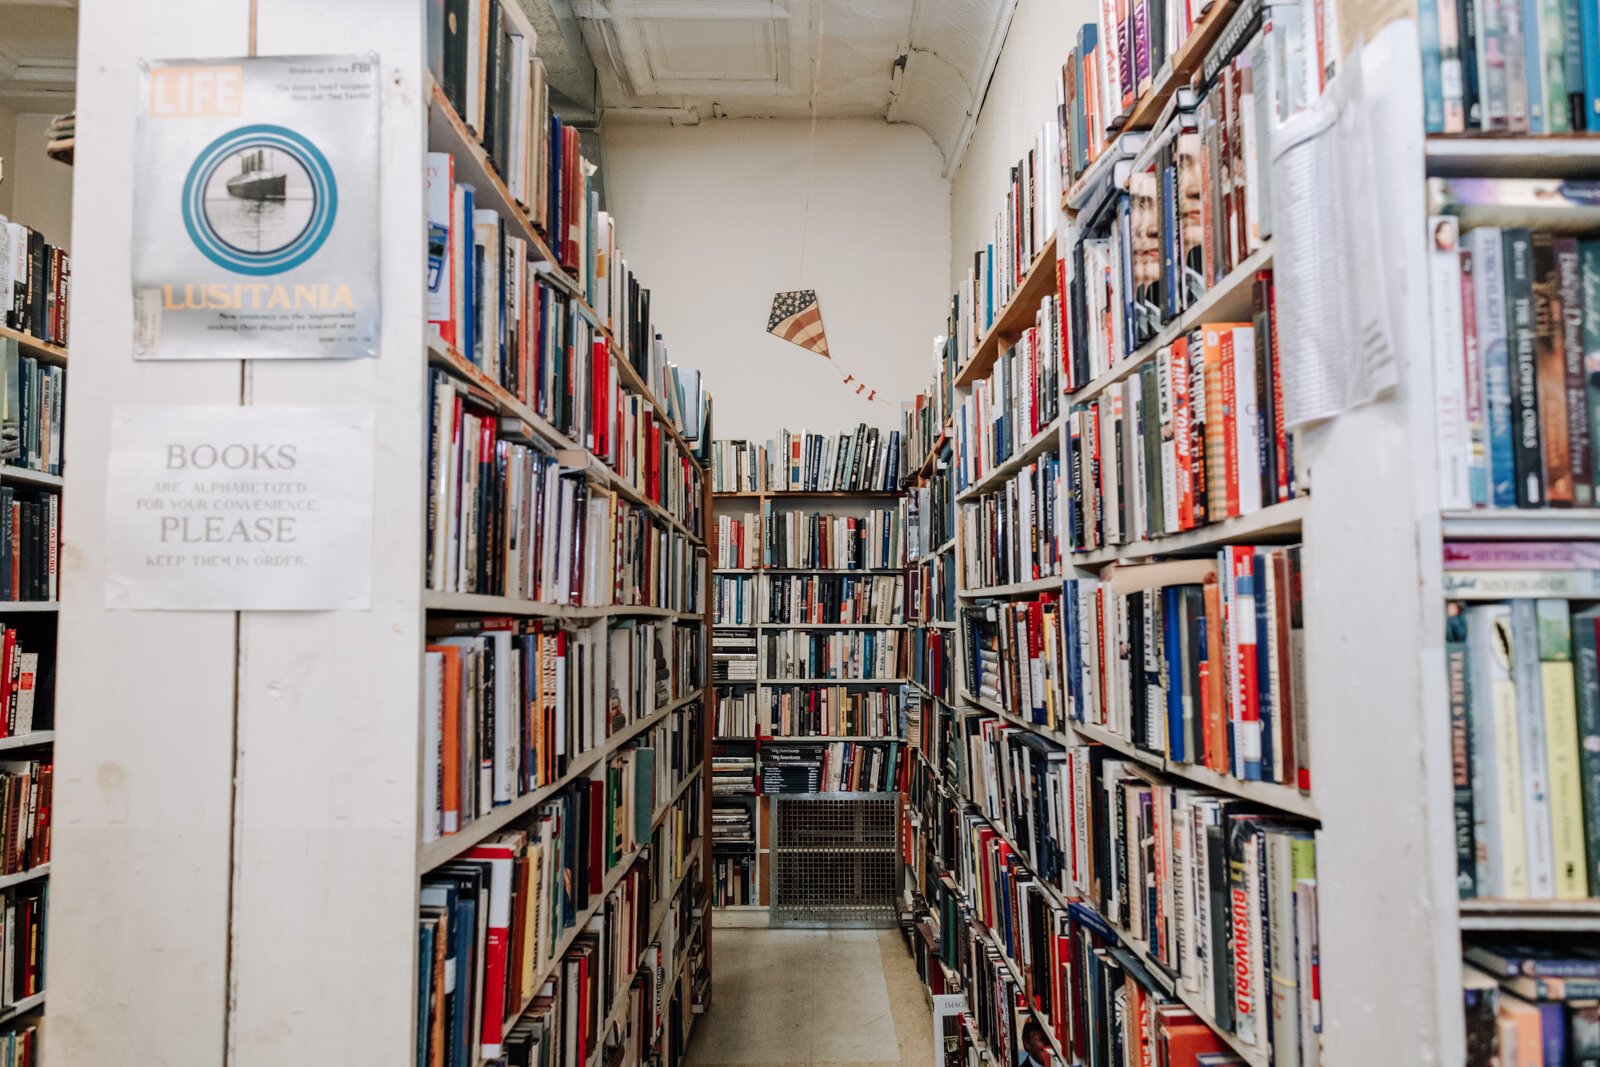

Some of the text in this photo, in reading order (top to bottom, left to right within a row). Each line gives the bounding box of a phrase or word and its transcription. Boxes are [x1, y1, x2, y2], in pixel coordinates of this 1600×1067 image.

[352, 63, 371, 73] FBI
[156, 71, 239, 113] LIFE
[163, 283, 356, 311] LUSITANIA
[1485, 238, 1502, 335] TORCHLIGHT
[207, 322, 237, 332] sinking
[240, 322, 256, 330] that
[260, 322, 293, 332] dragged
[308, 322, 337, 330] toward
[218, 311, 237, 320] New
[239, 312, 276, 320] evidence
[292, 311, 304, 320] the
[1515, 298, 1530, 326] THE
[1174, 356, 1187, 394] THIS
[1517, 328, 1535, 408] HALLOWED
[1178, 406, 1190, 457] TOWN
[1521, 409, 1538, 450] ONES
[165, 444, 298, 470] BOOKS
[153, 481, 307, 494] ARE ALPHABETIZED
[1072, 450, 1082, 503] AMERICAN
[136, 498, 164, 511] FOR
[169, 498, 209, 511] YOUR
[160, 516, 298, 543] PLEASE
[145, 555, 186, 568] KEEP
[192, 555, 231, 568] THEM
[234, 555, 249, 568] IN
[1450, 650, 1464, 702] TRAILS
[1452, 718, 1468, 786] TARGETS
[1233, 888, 1250, 1015] BUSHWORLD
